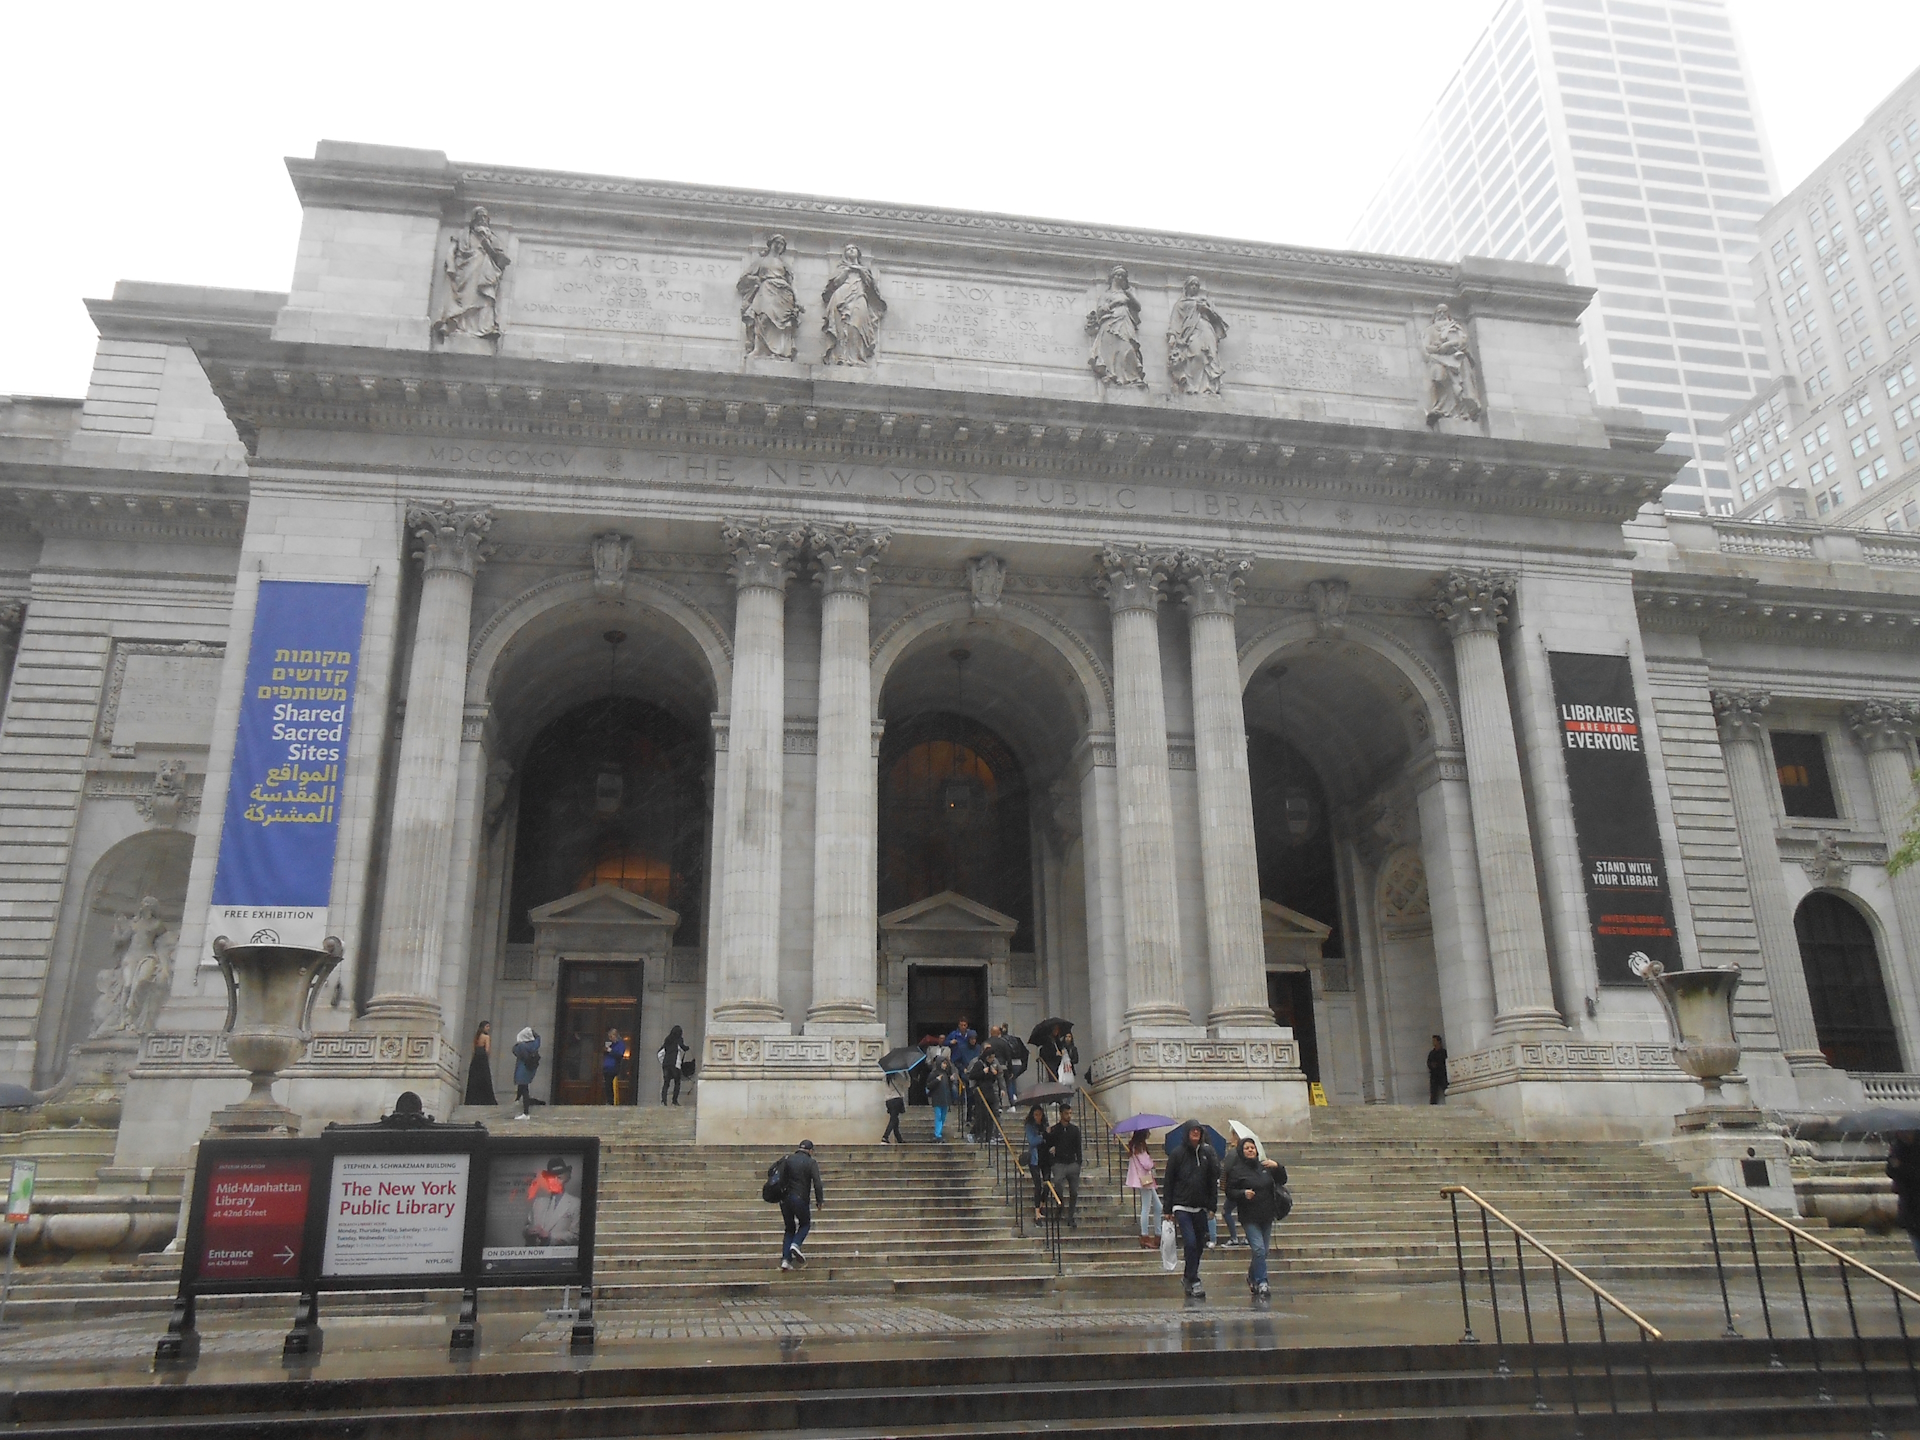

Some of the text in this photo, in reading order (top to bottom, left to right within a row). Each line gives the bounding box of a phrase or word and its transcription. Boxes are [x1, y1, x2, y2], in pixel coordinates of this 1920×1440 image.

[531, 249, 729, 279] THE ASTOR LIBRARY
[589, 274, 669, 289] FOUNDED BY
[553, 282, 701, 303] JOHN JACOB ASTOR
[892, 280, 1077, 310] THE LENOX LIBRARY
[601, 297, 652, 310] FOR THE
[947, 304, 1023, 319] FOUNDED BY
[521, 303, 732, 328] ADVANCEMENT OF USEFUL KNOWLEDGE
[932, 313, 1038, 332] JAMES LENOX
[915, 323, 976, 337] DEDICATED
[982, 328, 998, 339] TO
[1226, 312, 1396, 342] THE TILDEN TRUST
[888, 330, 1080, 357] LITERATURE AND THE FINE ARTS
[1279, 336, 1326, 348] FOUNDED
[953, 347, 1019, 361] MDCCCLXX
[1299, 348, 1337, 362] JONES
[1342, 351, 1383, 365] TILDEN
[1229, 362, 1271, 374] SCIENCE
[1279, 367, 1298, 377] AND
[1301, 369, 1345, 381] POPULAR
[1260, 355, 1288, 366] SERVE
[1295, 358, 1315, 369] THE
[1377, 366, 1389, 375] OF
[427, 445, 1484, 534] MDCCCXCV THE NEW YORK PUBLIC LIBRARY MDCCCCII
[275, 649, 351, 667] מקומות
[272, 667, 349, 686] קדושים
[258, 685, 347, 702] משותפים
[272, 703, 346, 722] Shared
[1561, 703, 1635, 724] LIBRARIES
[272, 723, 343, 742] Sacred
[1580, 722, 1624, 733] ARE FOR
[1566, 731, 1640, 752] EVERYONE
[288, 743, 340, 761] Sites
[266, 763, 338, 786] المواقع
[250, 783, 336, 804] المقدسة
[243, 804, 334, 827] المشتركة
[1596, 861, 1652, 874] STAND WITH
[1592, 873, 1659, 887] YOUR LIBRARY
[224, 910, 314, 919] FREE EXHIBITION
[216, 1182, 302, 1194] Mid-Manhattan
[342, 1180, 457, 1197] The New York
[215, 1195, 256, 1208] Library
[340, 1199, 456, 1219] Public Library
[244, 1209, 267, 1217] Street
[208, 1249, 254, 1259] Entrance
